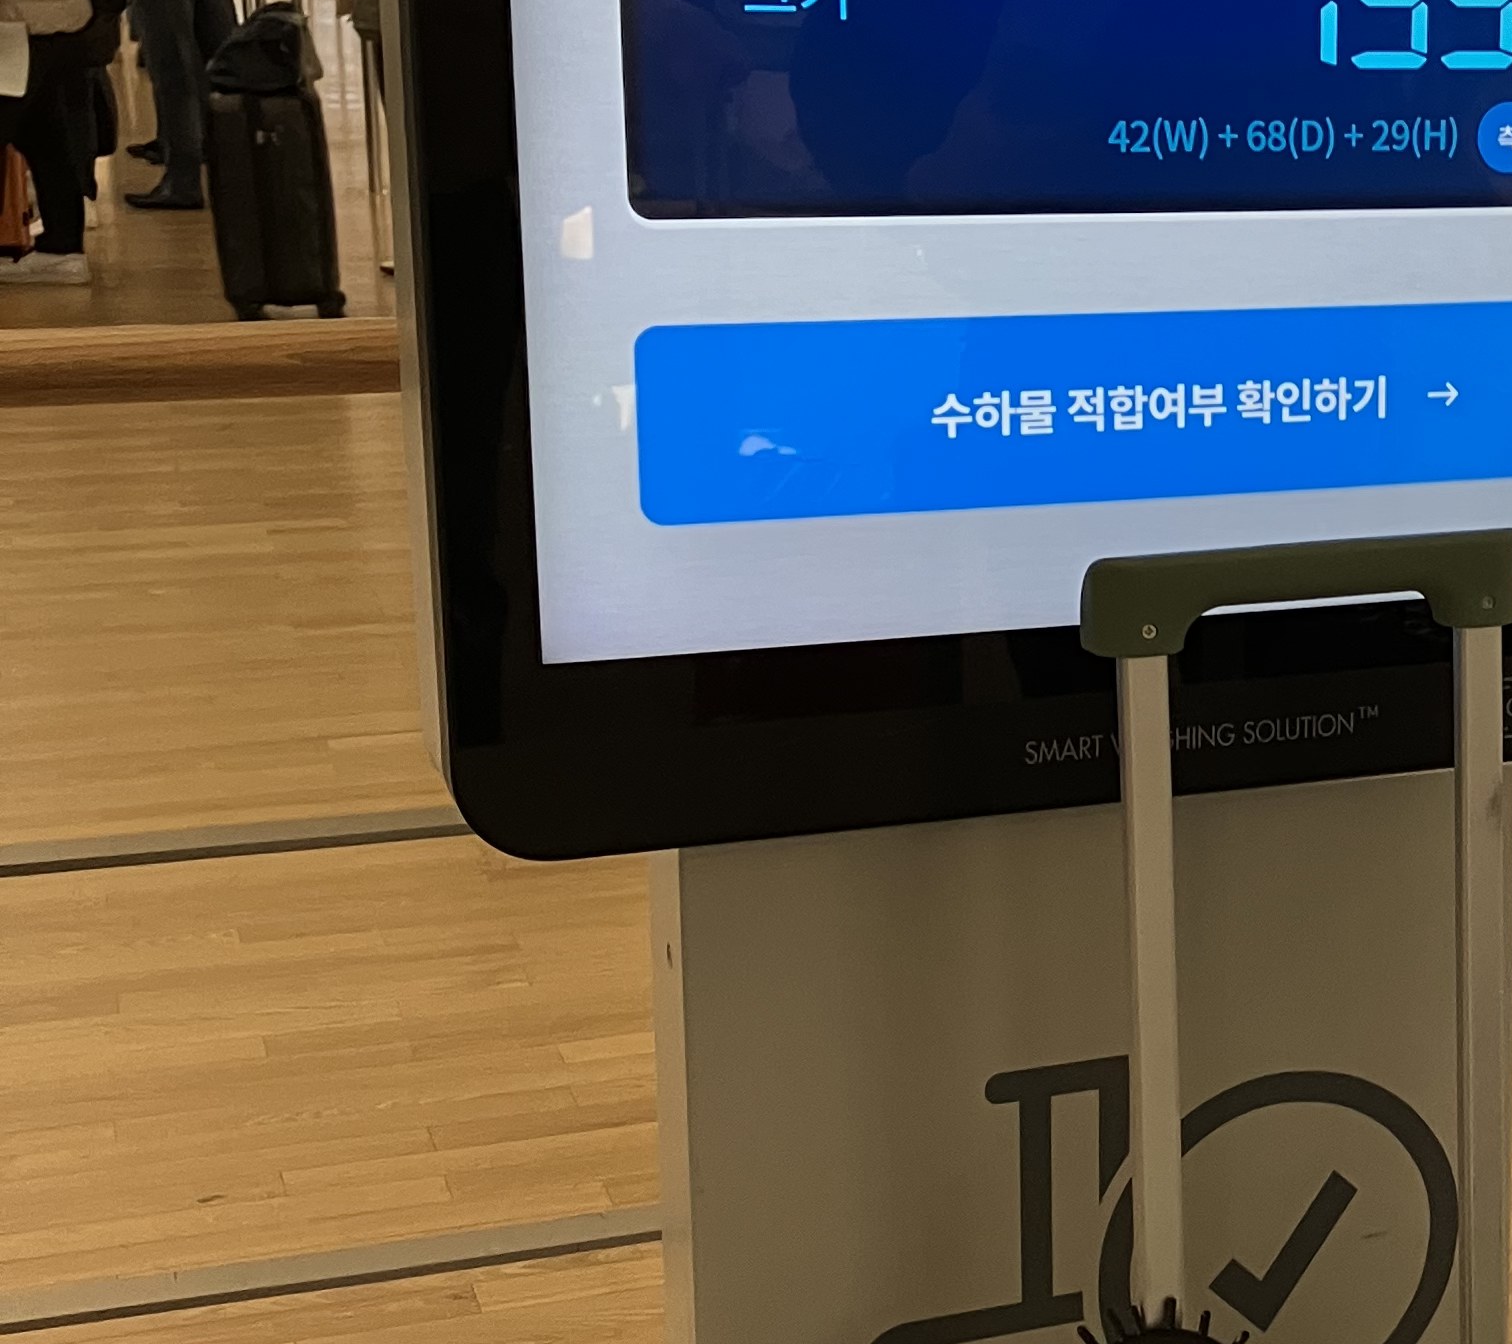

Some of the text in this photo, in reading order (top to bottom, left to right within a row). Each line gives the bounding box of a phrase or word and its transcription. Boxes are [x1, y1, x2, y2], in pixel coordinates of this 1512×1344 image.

[1108, 117, 1209, 160] 42(W)
[1246, 117, 1335, 160] 68(D)
[1370, 117, 1459, 159] 29(H)
[930, 375, 1388, 440] 수하물 적합여부 확인하기
[1024, 734, 1103, 765] SMART
[1111, 723, 1235, 756] HING
